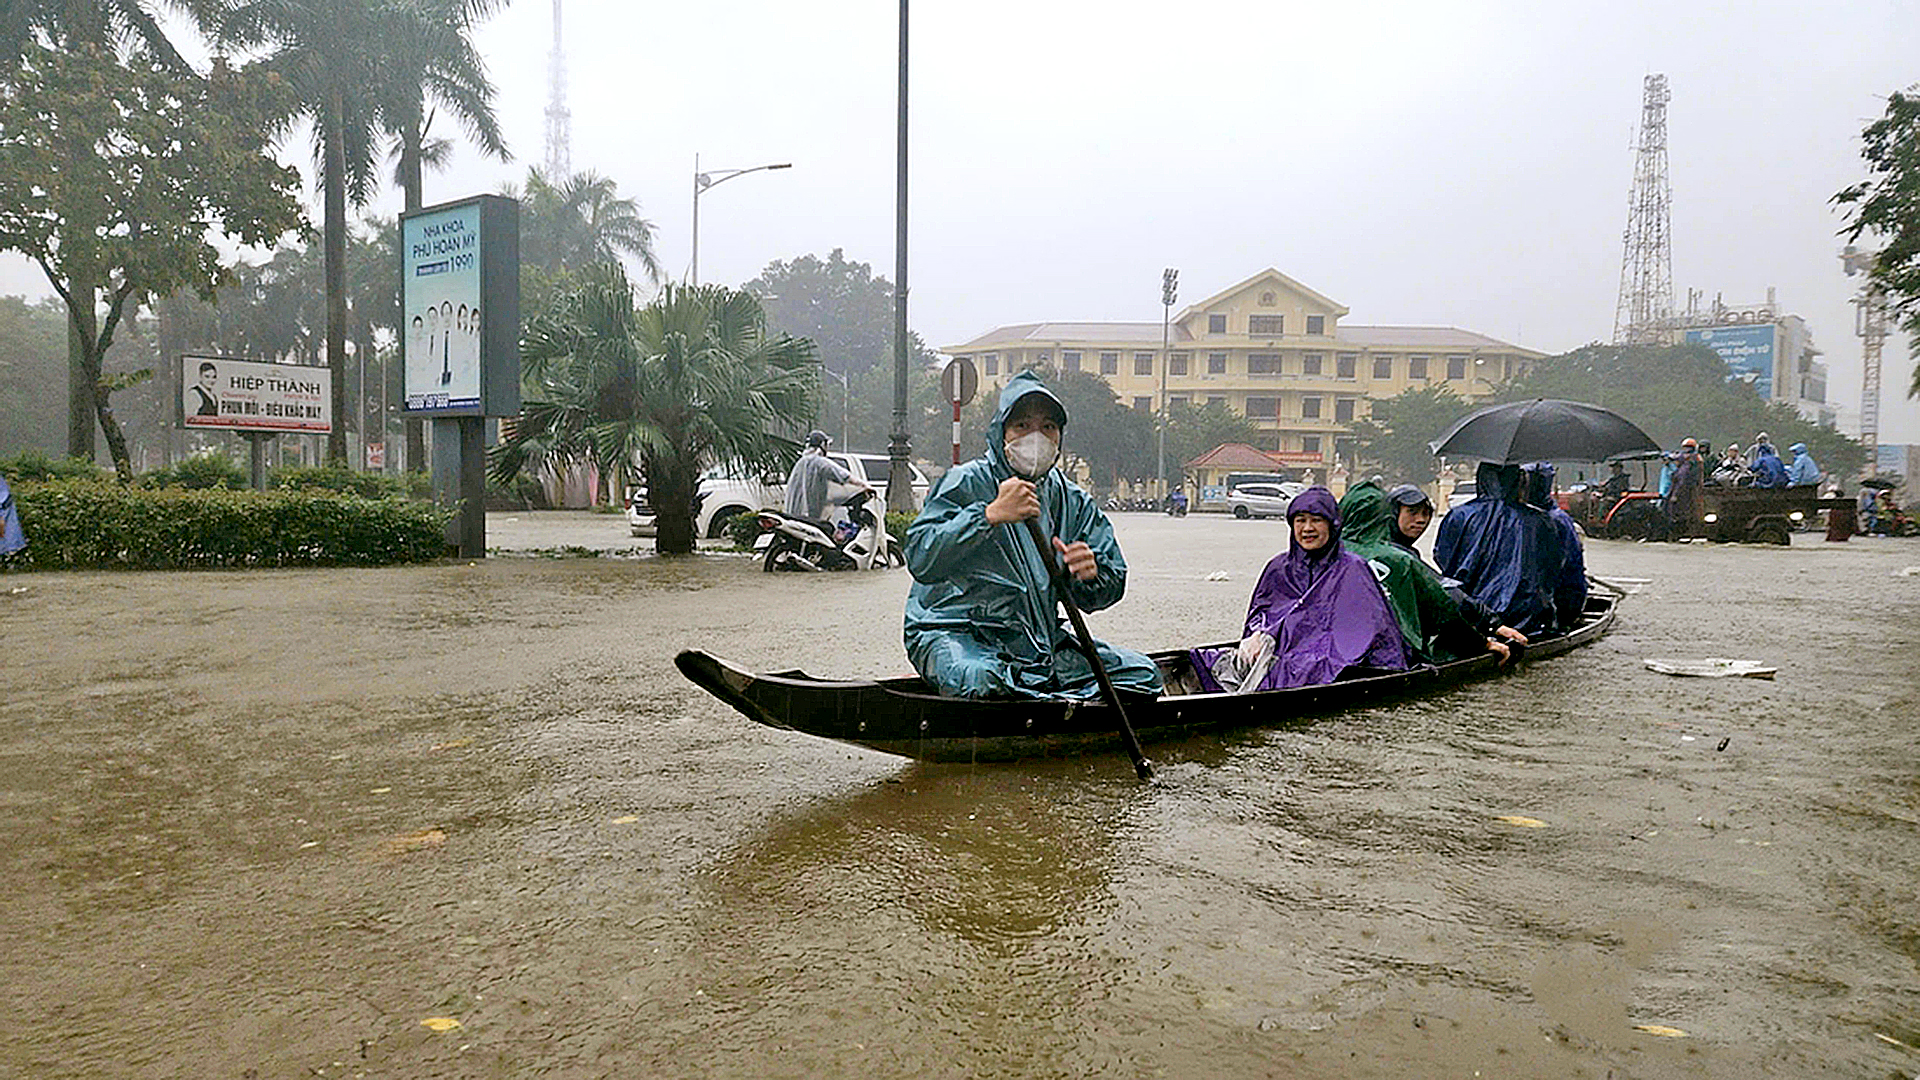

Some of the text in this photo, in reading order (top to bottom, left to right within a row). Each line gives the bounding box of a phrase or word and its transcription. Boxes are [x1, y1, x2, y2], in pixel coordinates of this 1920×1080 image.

[423, 219, 465, 238] NHA KHOA
[450, 253, 474, 272] 1990
[230, 374, 264, 391] HIỆP
[267, 378, 320, 395] THÀNH
